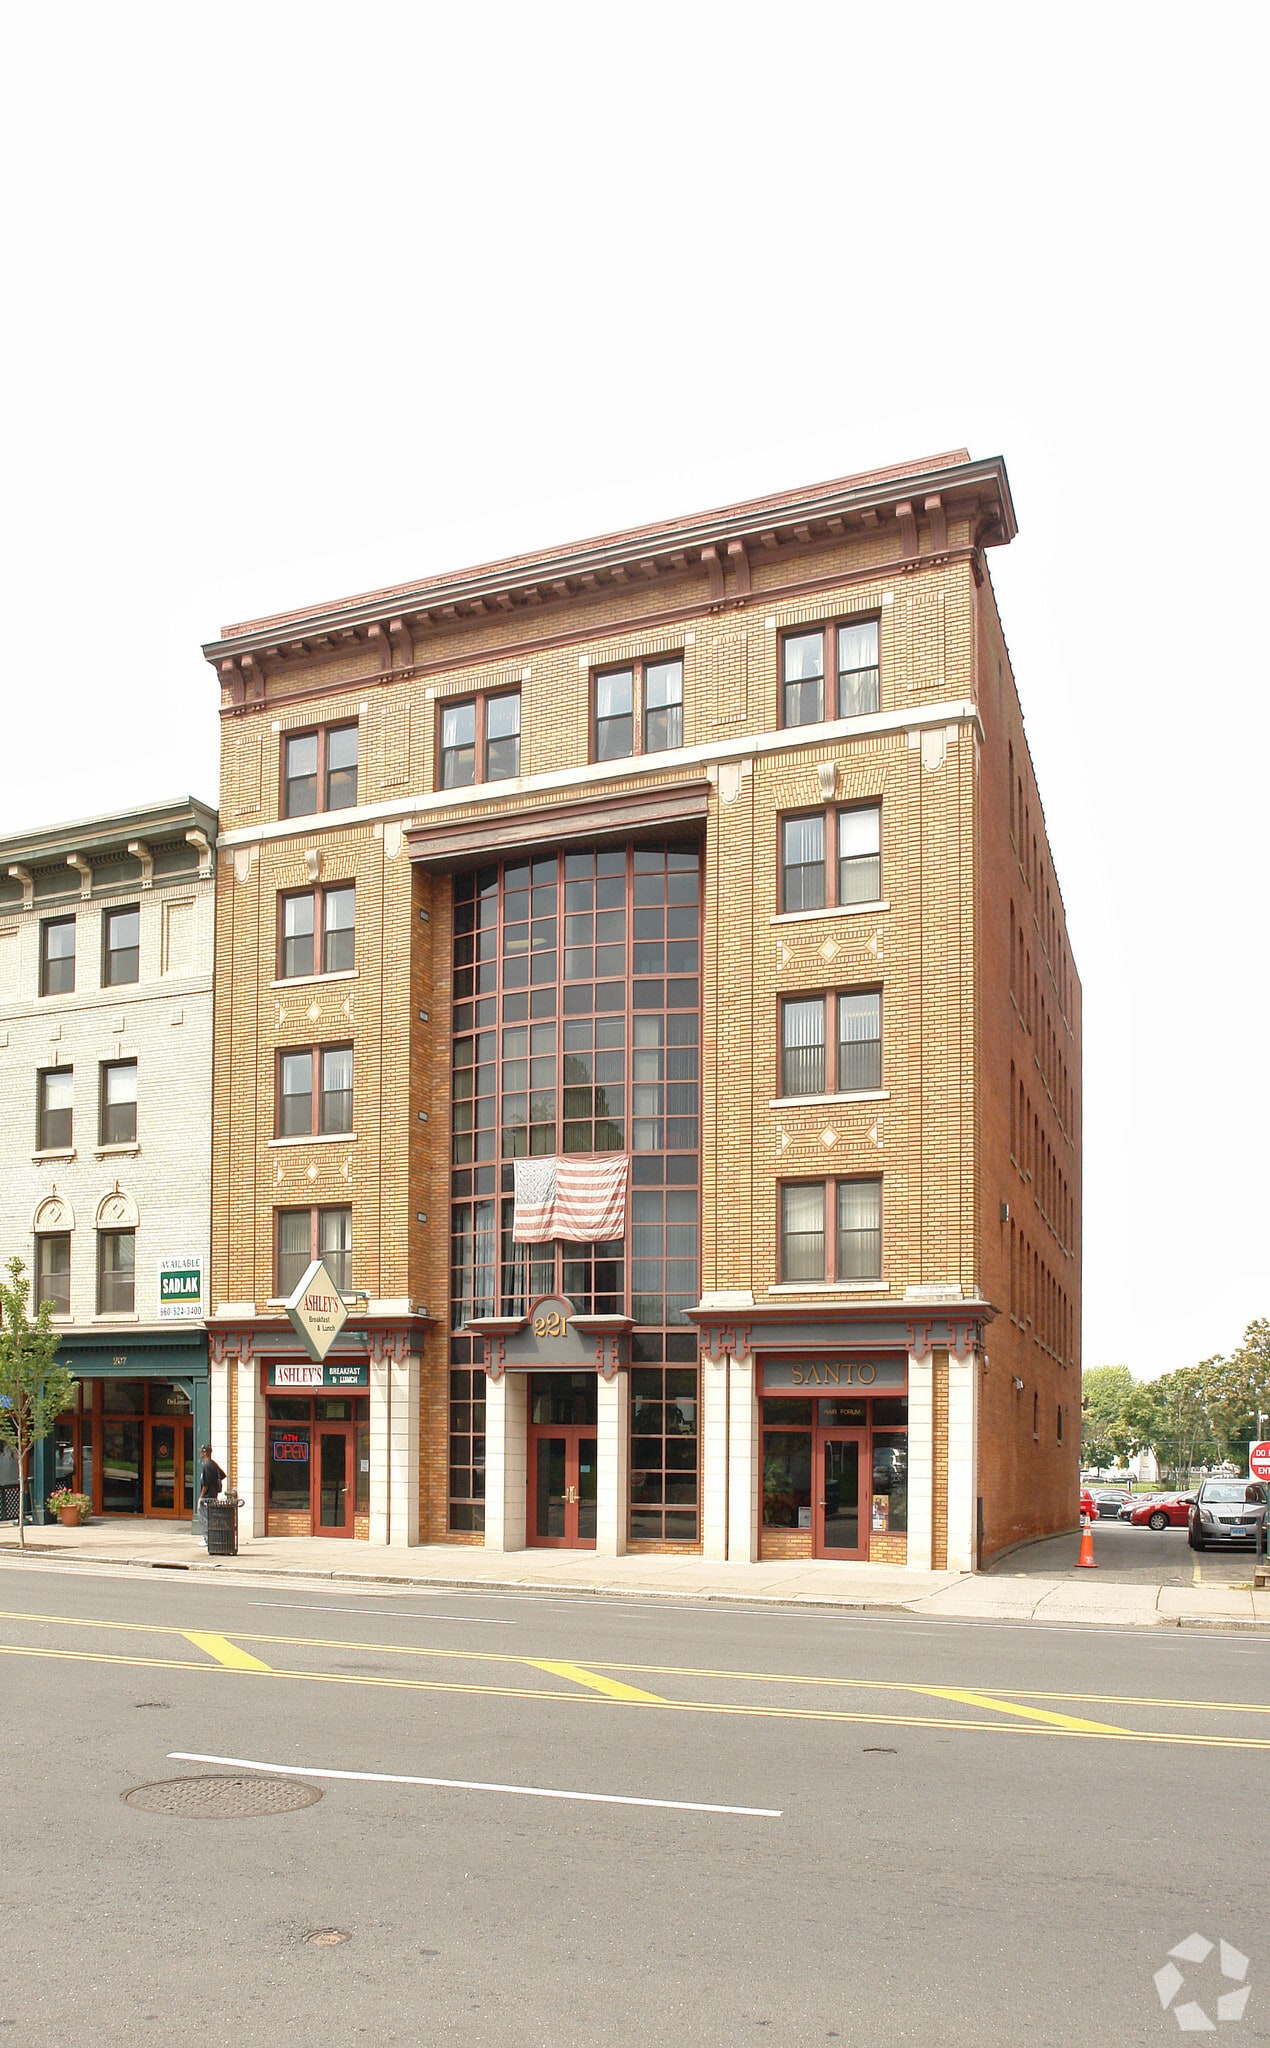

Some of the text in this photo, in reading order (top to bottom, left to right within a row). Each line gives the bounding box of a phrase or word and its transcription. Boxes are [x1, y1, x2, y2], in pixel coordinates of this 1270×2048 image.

[161, 1259, 200, 1269] AVAILABLE
[162, 1276, 198, 1294] SADLAK
[304, 1295, 339, 1313] ASHLEY'S
[534, 1311, 567, 1337] 221
[278, 1367, 322, 1383] ASHLEY'S
[329, 1367, 360, 1375] BREAKFAST
[791, 1363, 876, 1384] SANTO
[339, 1376, 358, 1384] LUNCH
[275, 1444, 307, 1459] OPEN
